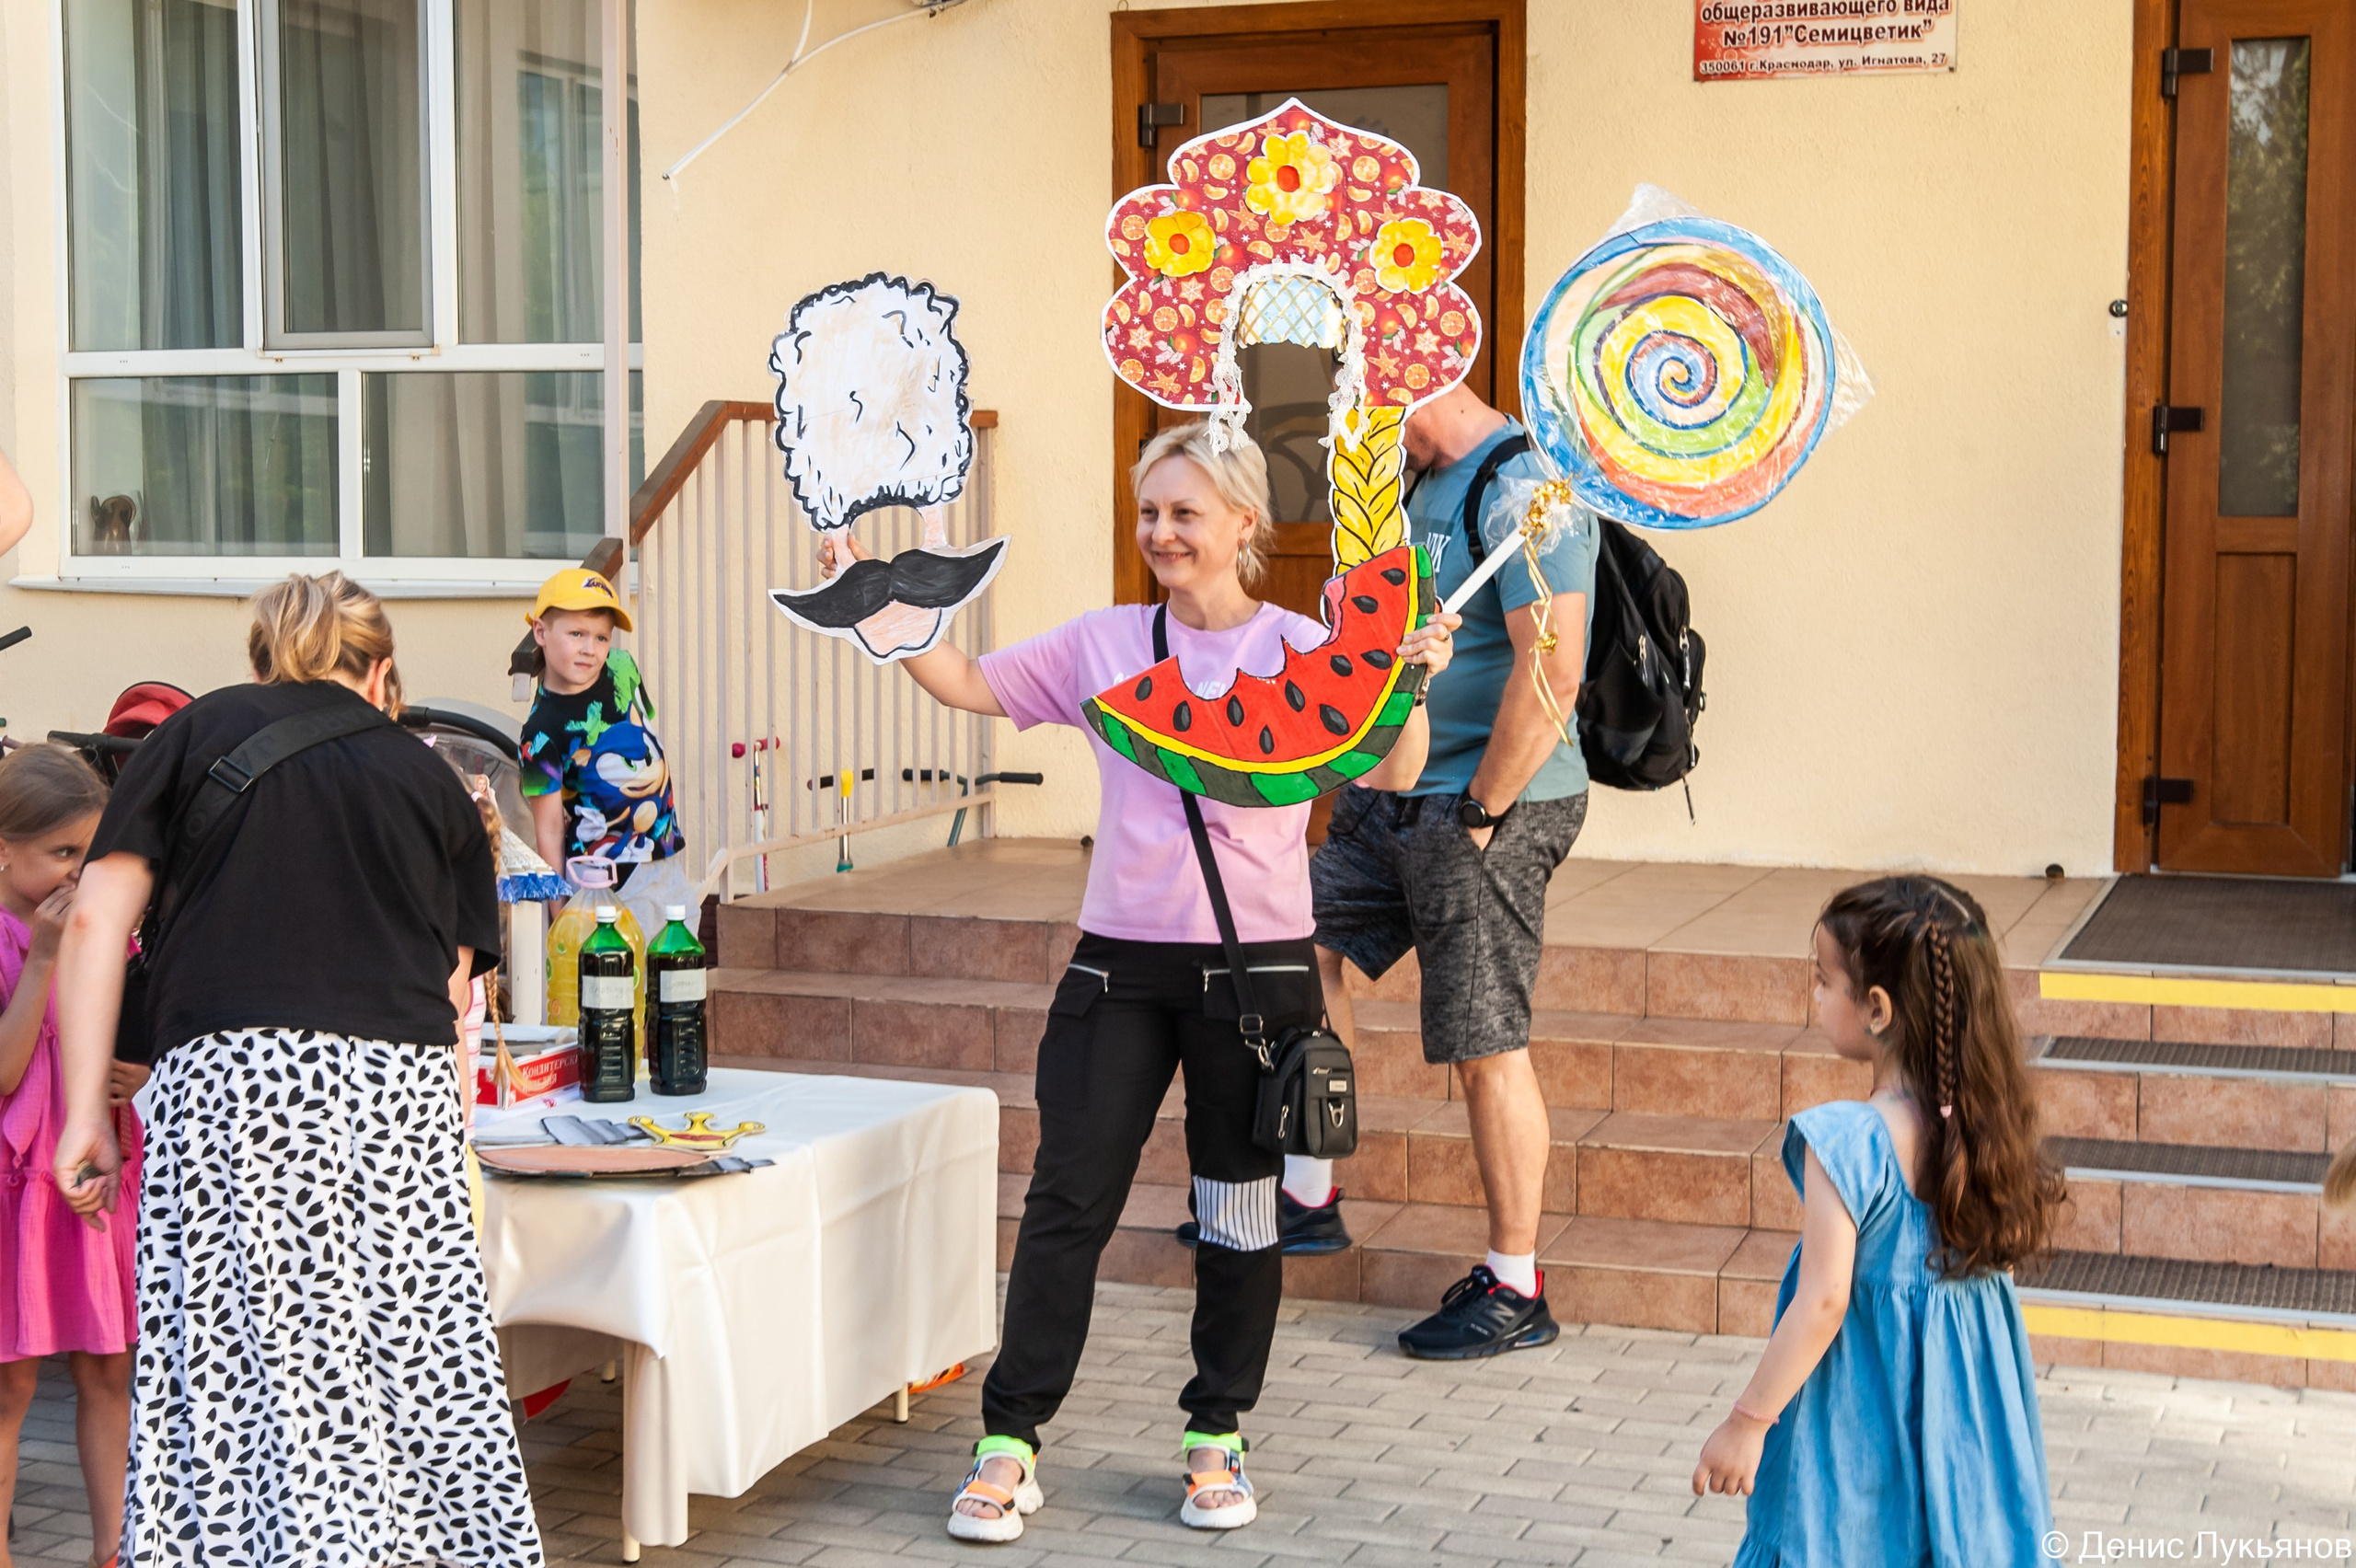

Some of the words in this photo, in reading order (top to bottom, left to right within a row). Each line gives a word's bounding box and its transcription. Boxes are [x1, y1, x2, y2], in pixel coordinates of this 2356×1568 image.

[1702, 0, 1897, 23] общеразвивающего
[1903, 0, 1949, 15] вида
[1700, 60, 1744, 73] 350061
[1838, 57, 1857, 70] ул.
[1862, 54, 1926, 67] Игнатова,
[1932, 52, 1946, 63] 27
